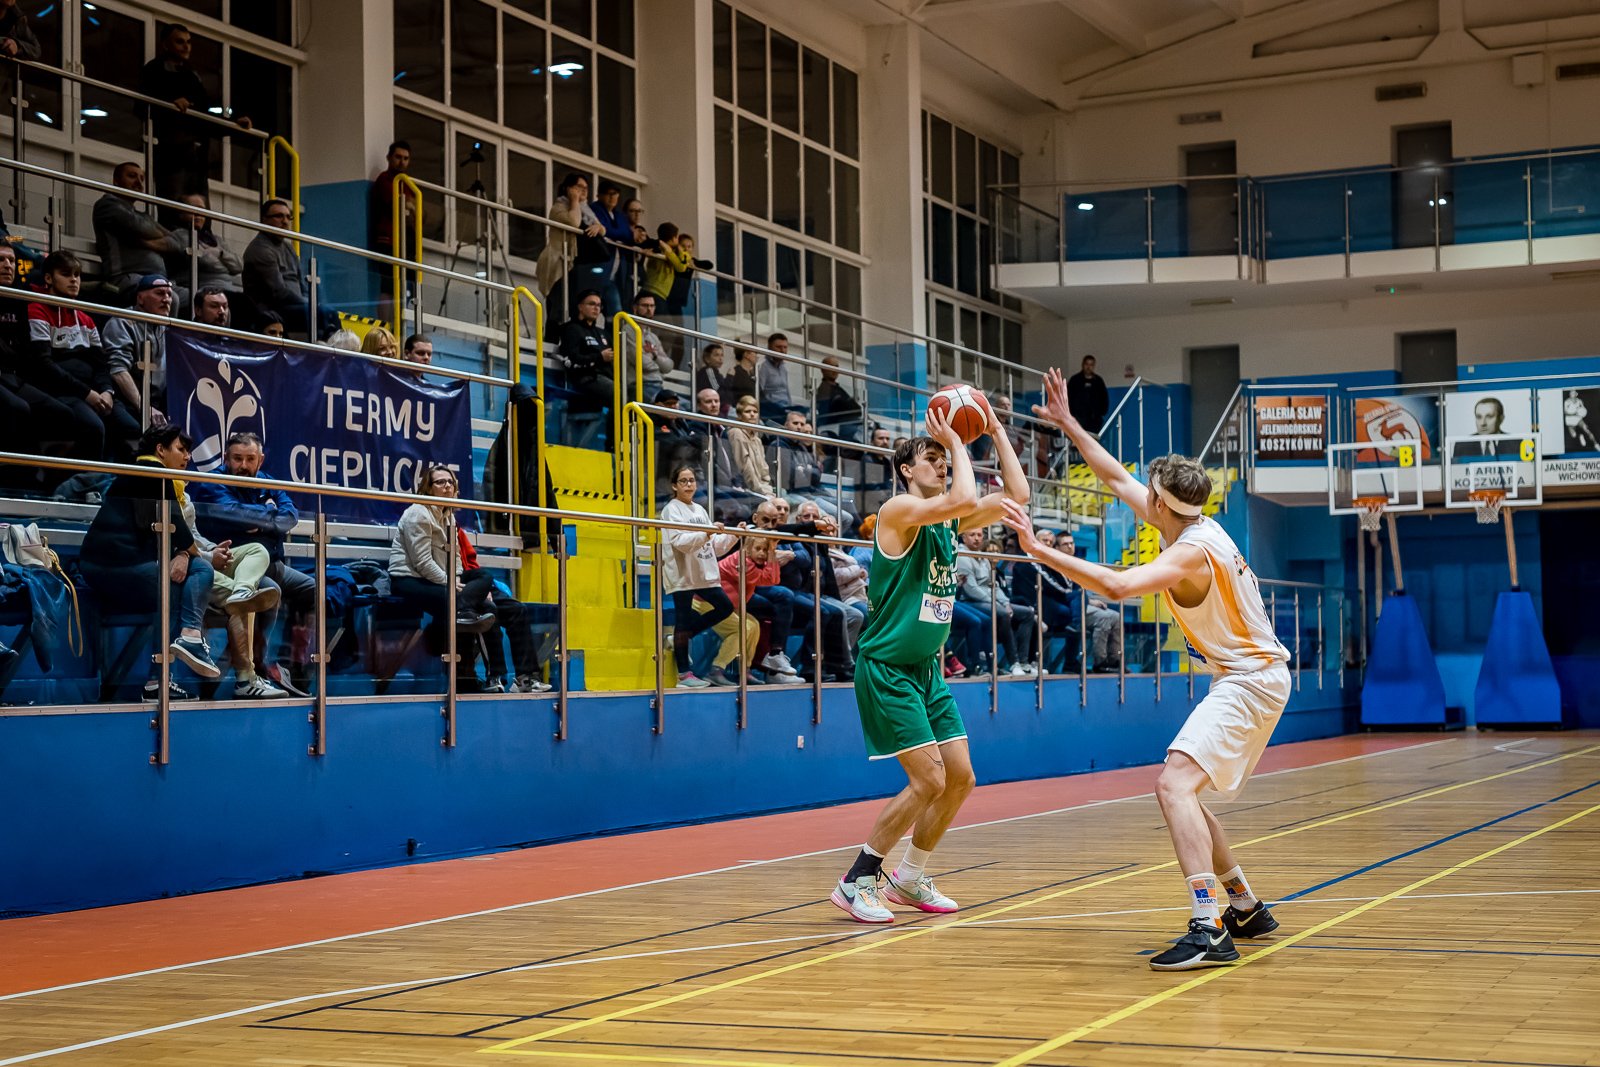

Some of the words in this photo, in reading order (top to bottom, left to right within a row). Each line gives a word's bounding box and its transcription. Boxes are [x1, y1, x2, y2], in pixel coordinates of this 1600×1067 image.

[323, 385, 435, 442] TERMY
[1260, 407, 1296, 420] GALERIA
[1297, 406, 1322, 420] SŁAW
[1398, 446, 1414, 467] B
[1519, 439, 1535, 462] C
[1544, 461, 1578, 472] JANUSZ
